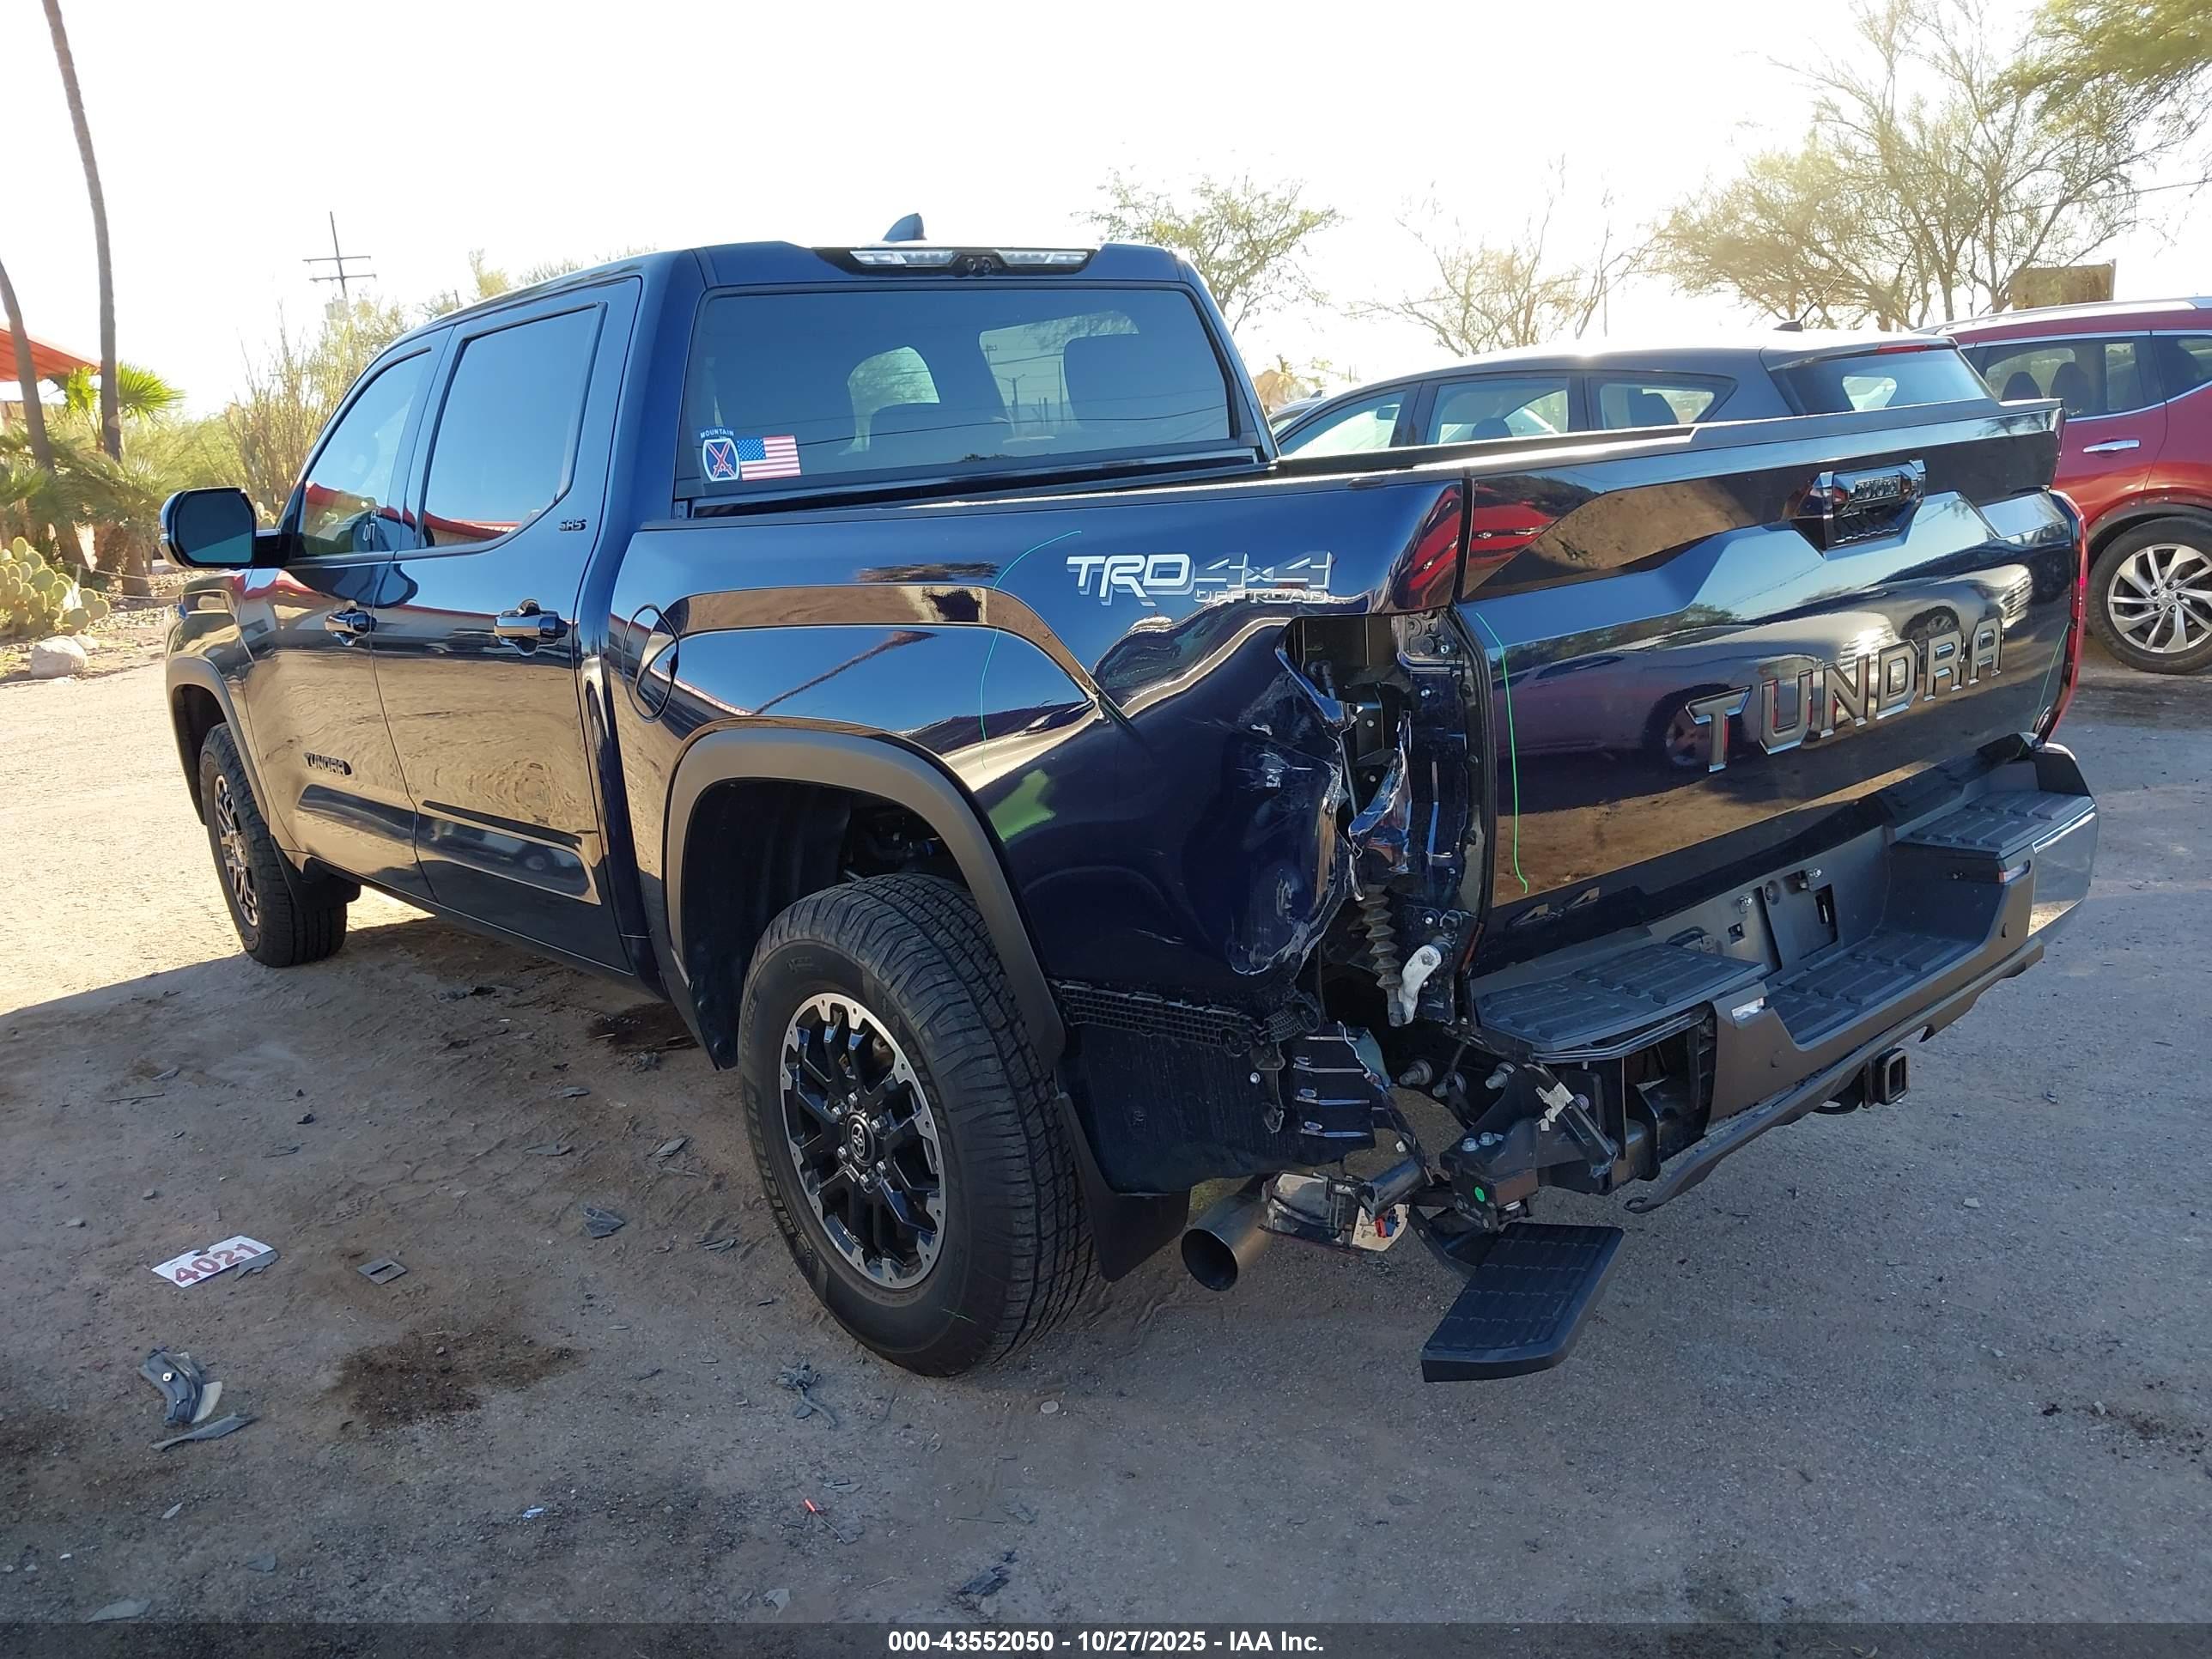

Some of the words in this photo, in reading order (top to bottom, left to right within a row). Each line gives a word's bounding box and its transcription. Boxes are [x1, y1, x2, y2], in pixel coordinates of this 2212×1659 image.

[700, 428, 734, 439] MOUNTAIN
[1066, 554, 1195, 606] TRD
[1685, 617, 2003, 773] TUNDRA
[303, 751, 344, 775] TUNDRA
[175, 1243, 261, 1283] 4021
